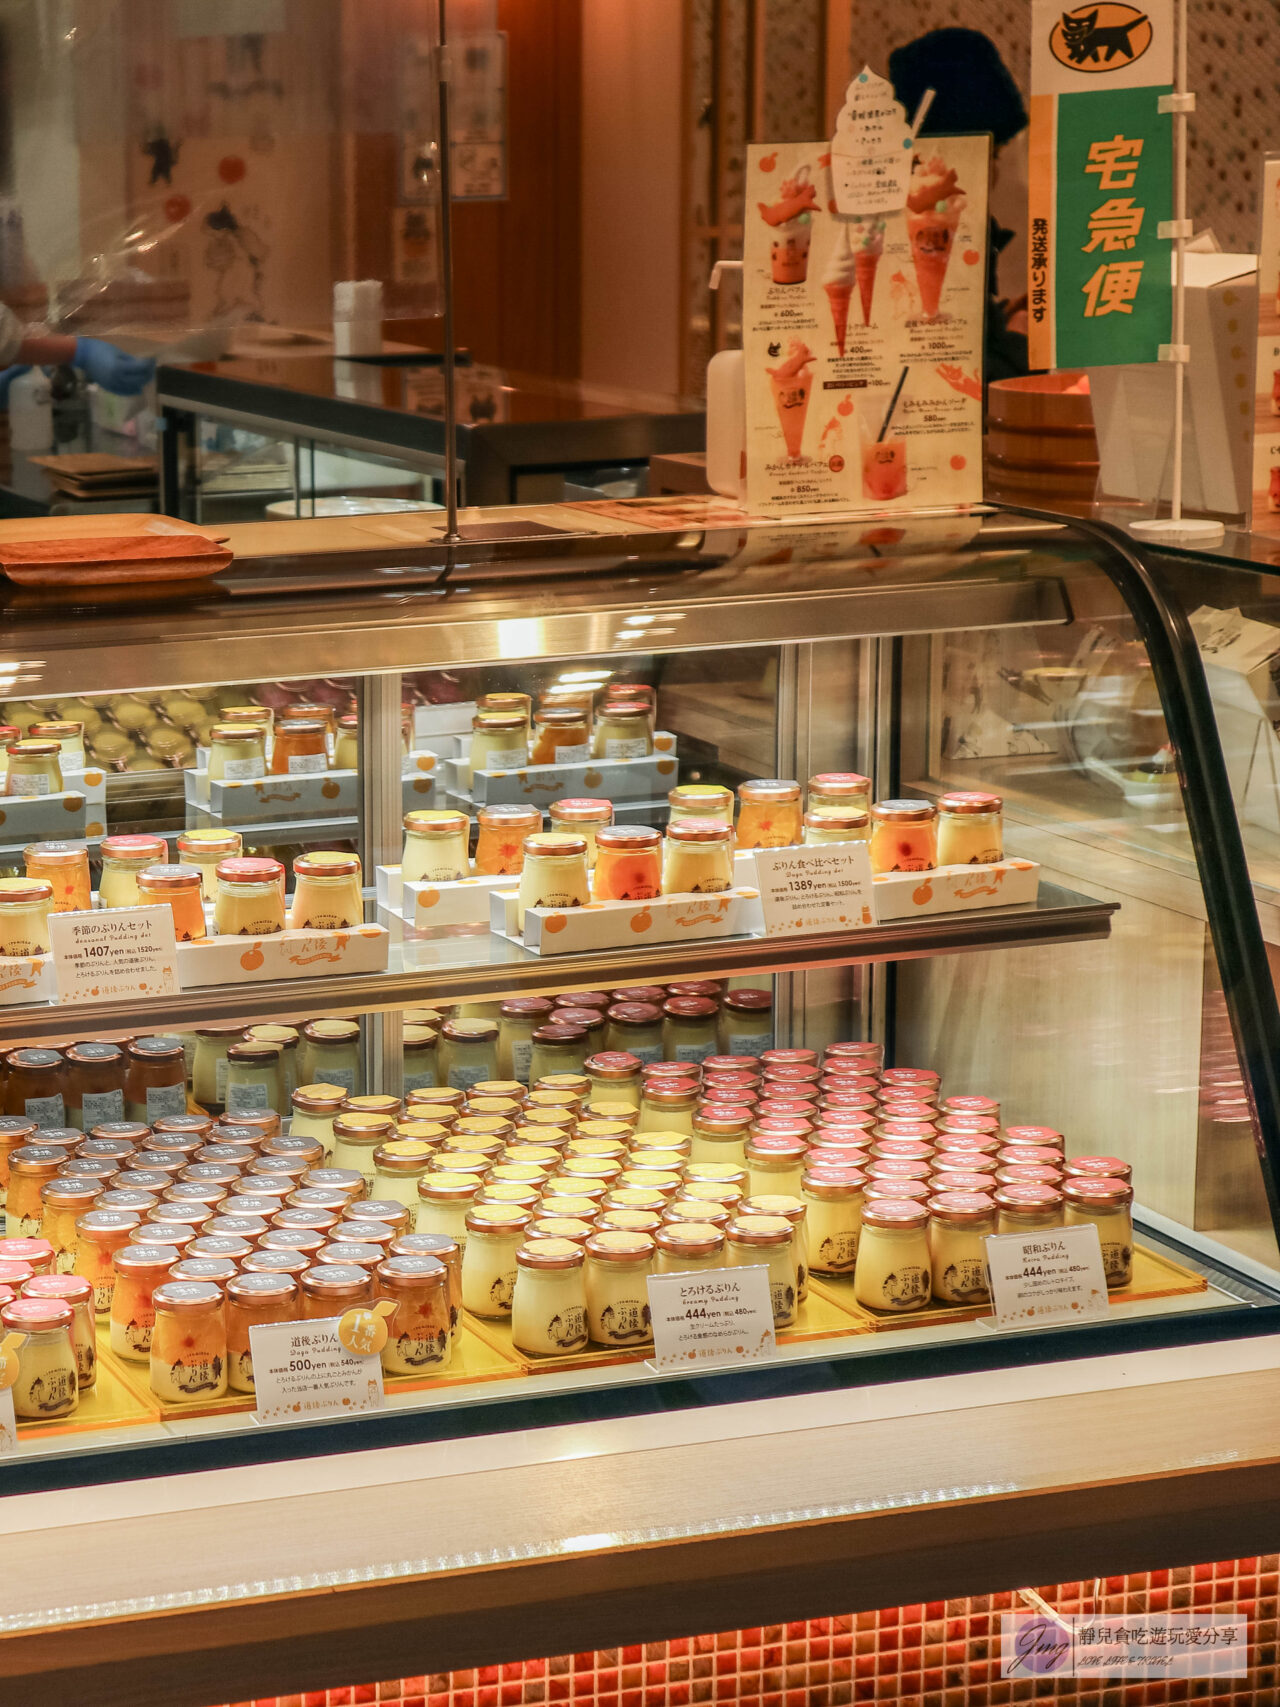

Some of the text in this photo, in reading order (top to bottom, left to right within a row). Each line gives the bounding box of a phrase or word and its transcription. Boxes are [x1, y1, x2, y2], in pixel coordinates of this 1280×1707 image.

[1081, 134, 1145, 318] 宅急便
[1031, 218, 1048, 323] 発送承ります
[772, 855, 855, 871] ぷりん食べ比べセット
[788, 879, 827, 892] 1389yen
[72, 919, 153, 936] 季節のぷりんセット
[83, 945, 124, 958] 1407yen
[1022, 1240, 1066, 1255] 昭和ぷりん
[1023, 1265, 1057, 1278] 444yen
[680, 1282, 741, 1298] とろけるぷりん
[685, 1307, 721, 1320] 444yen
[290, 1333, 339, 1348] 道後ぷりん
[346, 1335, 372, 1353] 人気
[289, 1359, 327, 1372] 500yen
